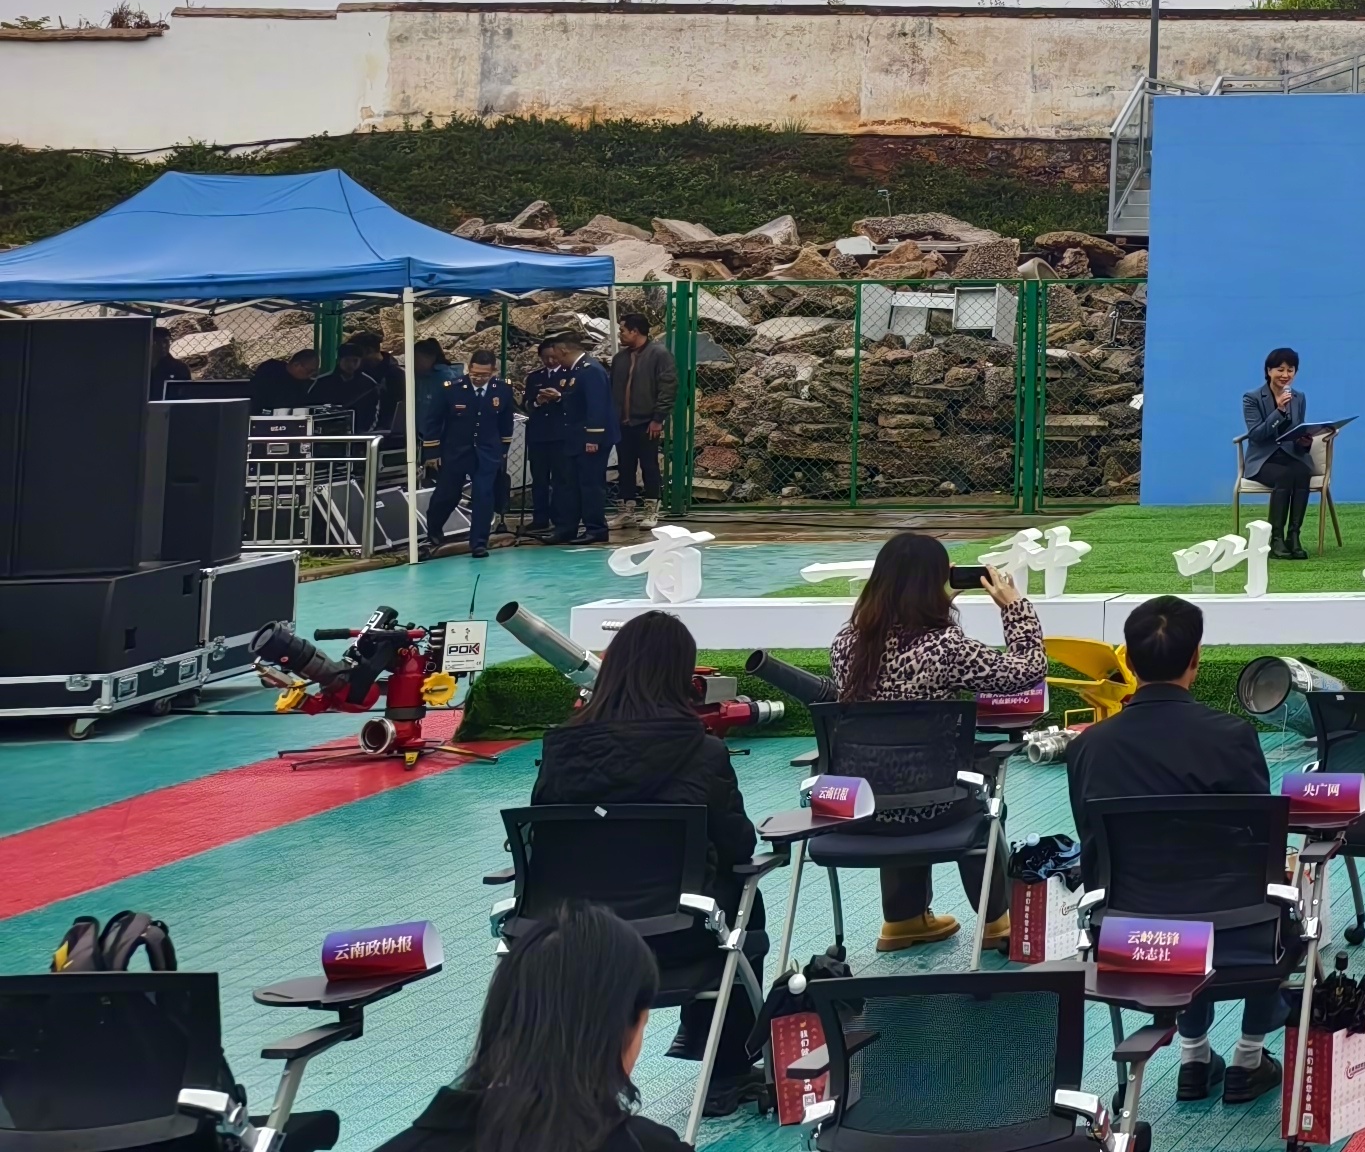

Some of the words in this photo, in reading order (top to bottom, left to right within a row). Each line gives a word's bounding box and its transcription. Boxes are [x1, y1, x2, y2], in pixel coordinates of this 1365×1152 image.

[449, 643, 480, 655] POK
[818, 786, 848, 801] 云南日报
[1303, 782, 1341, 797] 央广网
[1127, 930, 1181, 945] 云岭先锋
[333, 935, 413, 961] 云南政协报
[1131, 946, 1171, 962] 杂志社
